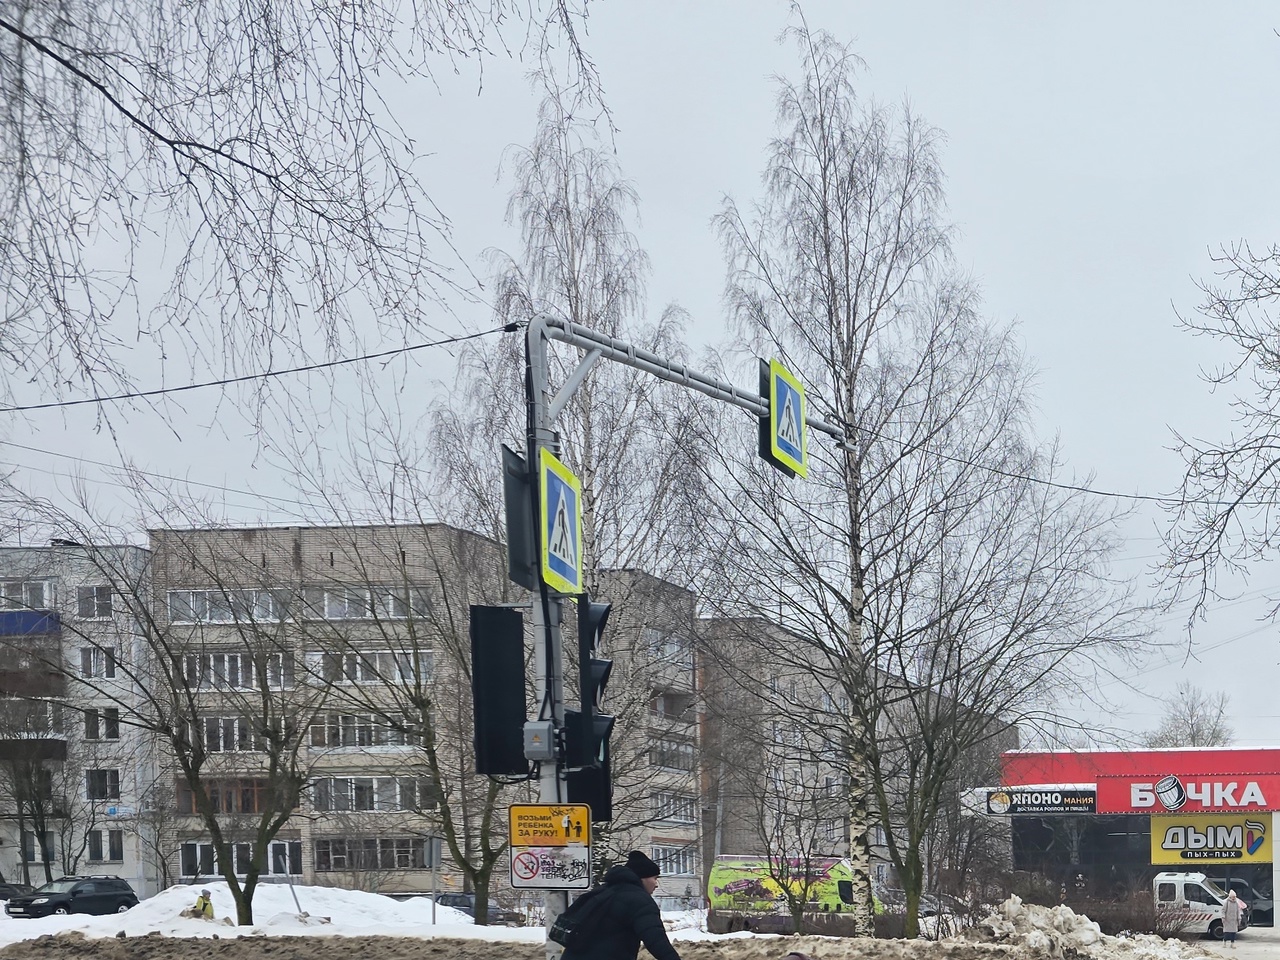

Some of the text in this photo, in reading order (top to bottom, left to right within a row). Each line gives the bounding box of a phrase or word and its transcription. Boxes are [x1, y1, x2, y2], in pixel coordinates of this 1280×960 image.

[1012, 792, 1062, 805] ЯПОНО
[518, 829, 558, 837] ЗА РУКУ!
[1162, 826, 1243, 850] ДЫМ
